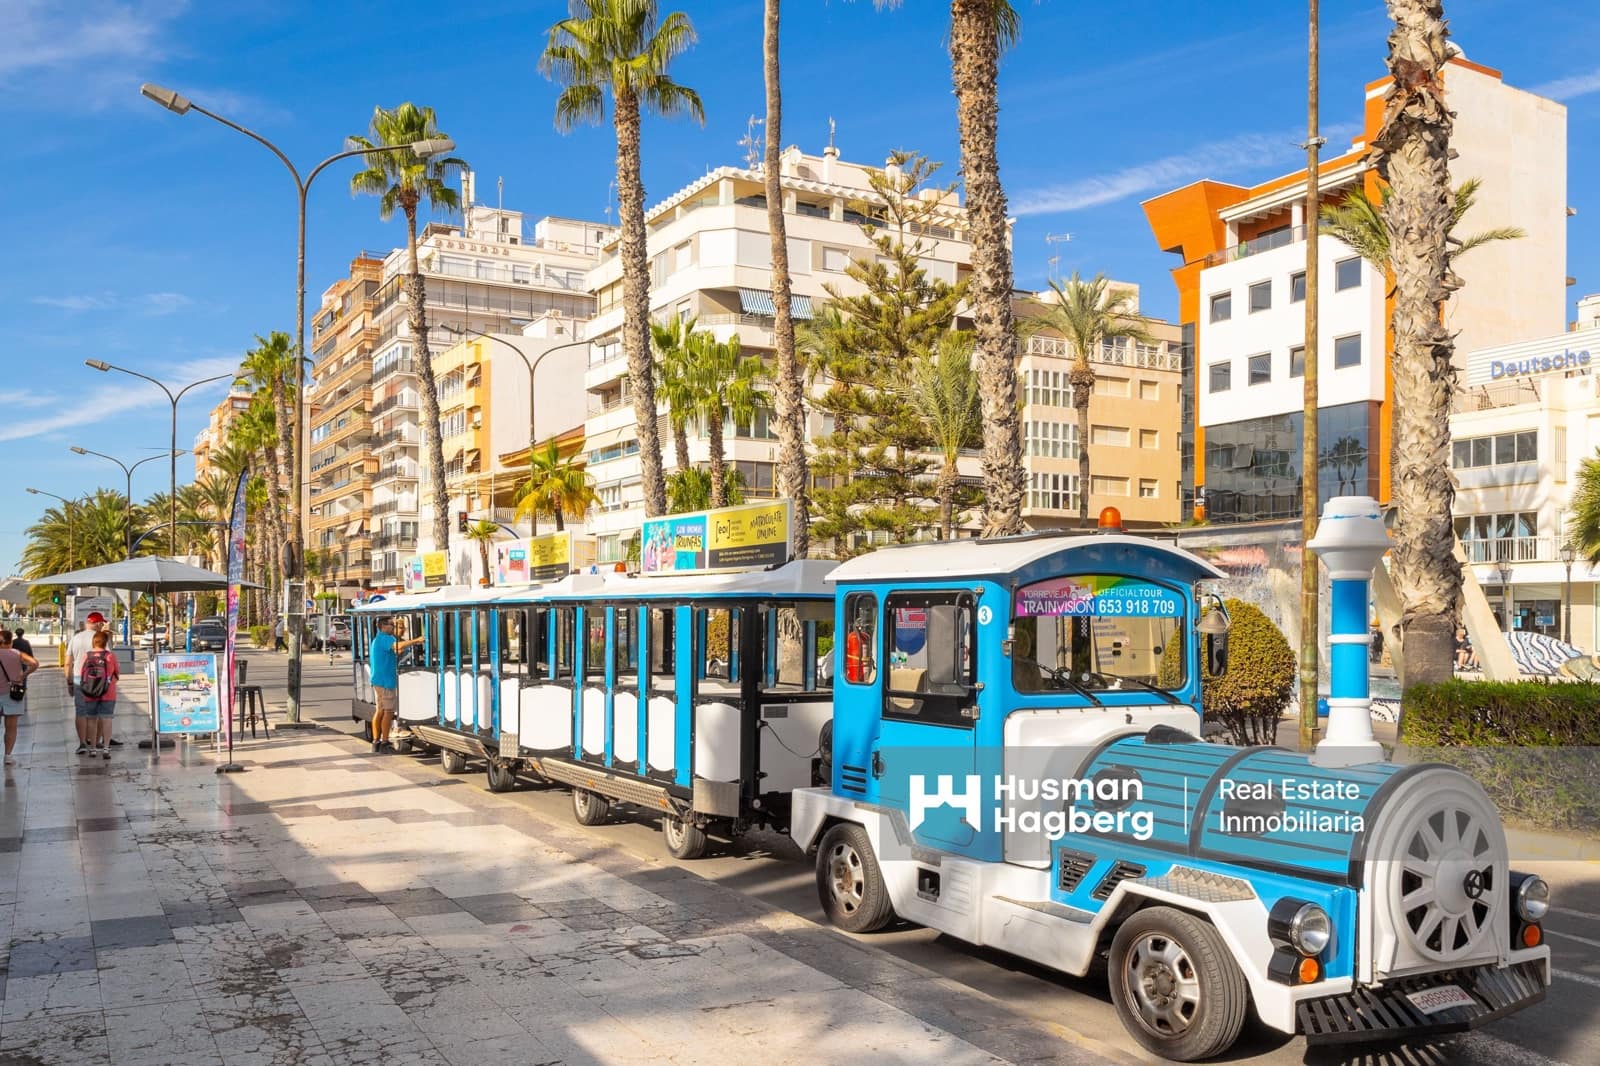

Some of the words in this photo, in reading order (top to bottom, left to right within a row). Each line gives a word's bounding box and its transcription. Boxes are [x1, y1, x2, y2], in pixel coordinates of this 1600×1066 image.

[1491, 348, 1591, 379] Deutsche
[757, 526, 776, 539] ONLINE
[1023, 590, 1068, 599] TORREVIEJA
[1023, 600, 1094, 613] TRAINVISION
[1099, 600, 1122, 614] 653
[1126, 600, 1149, 614] 918
[1153, 600, 1175, 614] 709
[981, 608, 988, 622] 3
